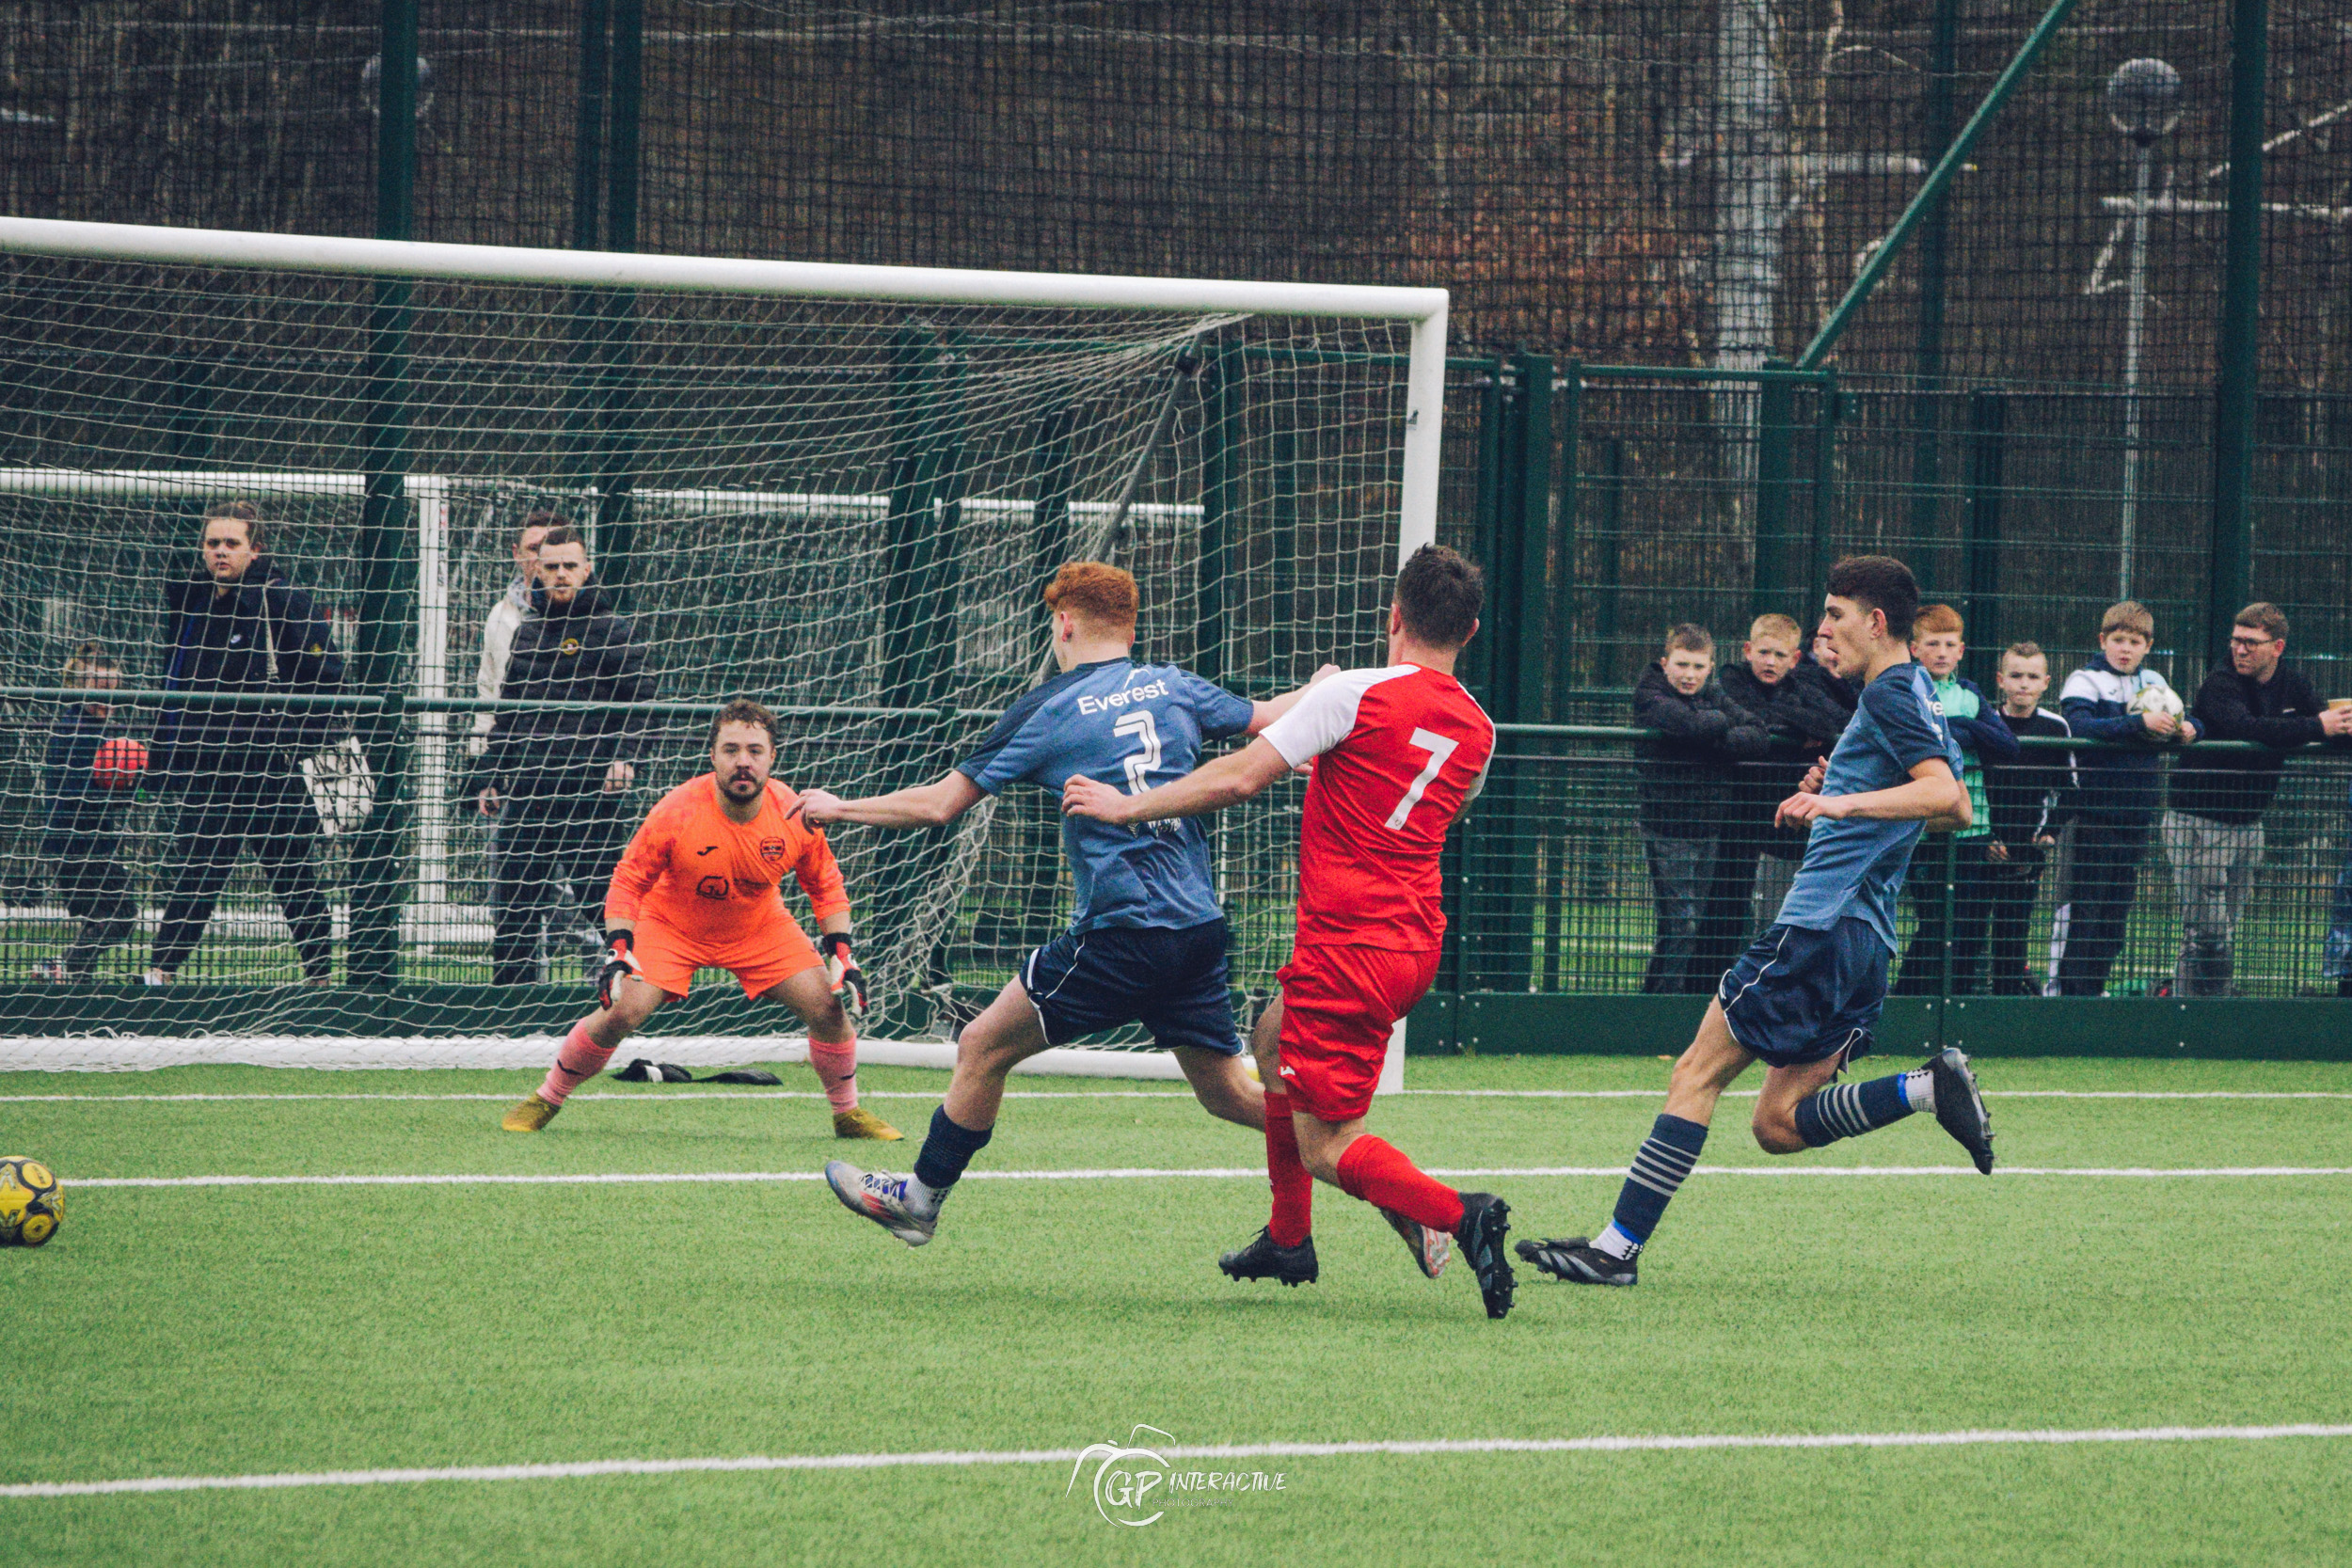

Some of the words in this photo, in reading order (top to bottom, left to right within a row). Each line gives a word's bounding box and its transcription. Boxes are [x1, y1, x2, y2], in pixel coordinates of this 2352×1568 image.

[1077, 679, 1168, 715] Everest
[1113, 709, 1171, 796] 2
[1384, 726, 1459, 831] 7
